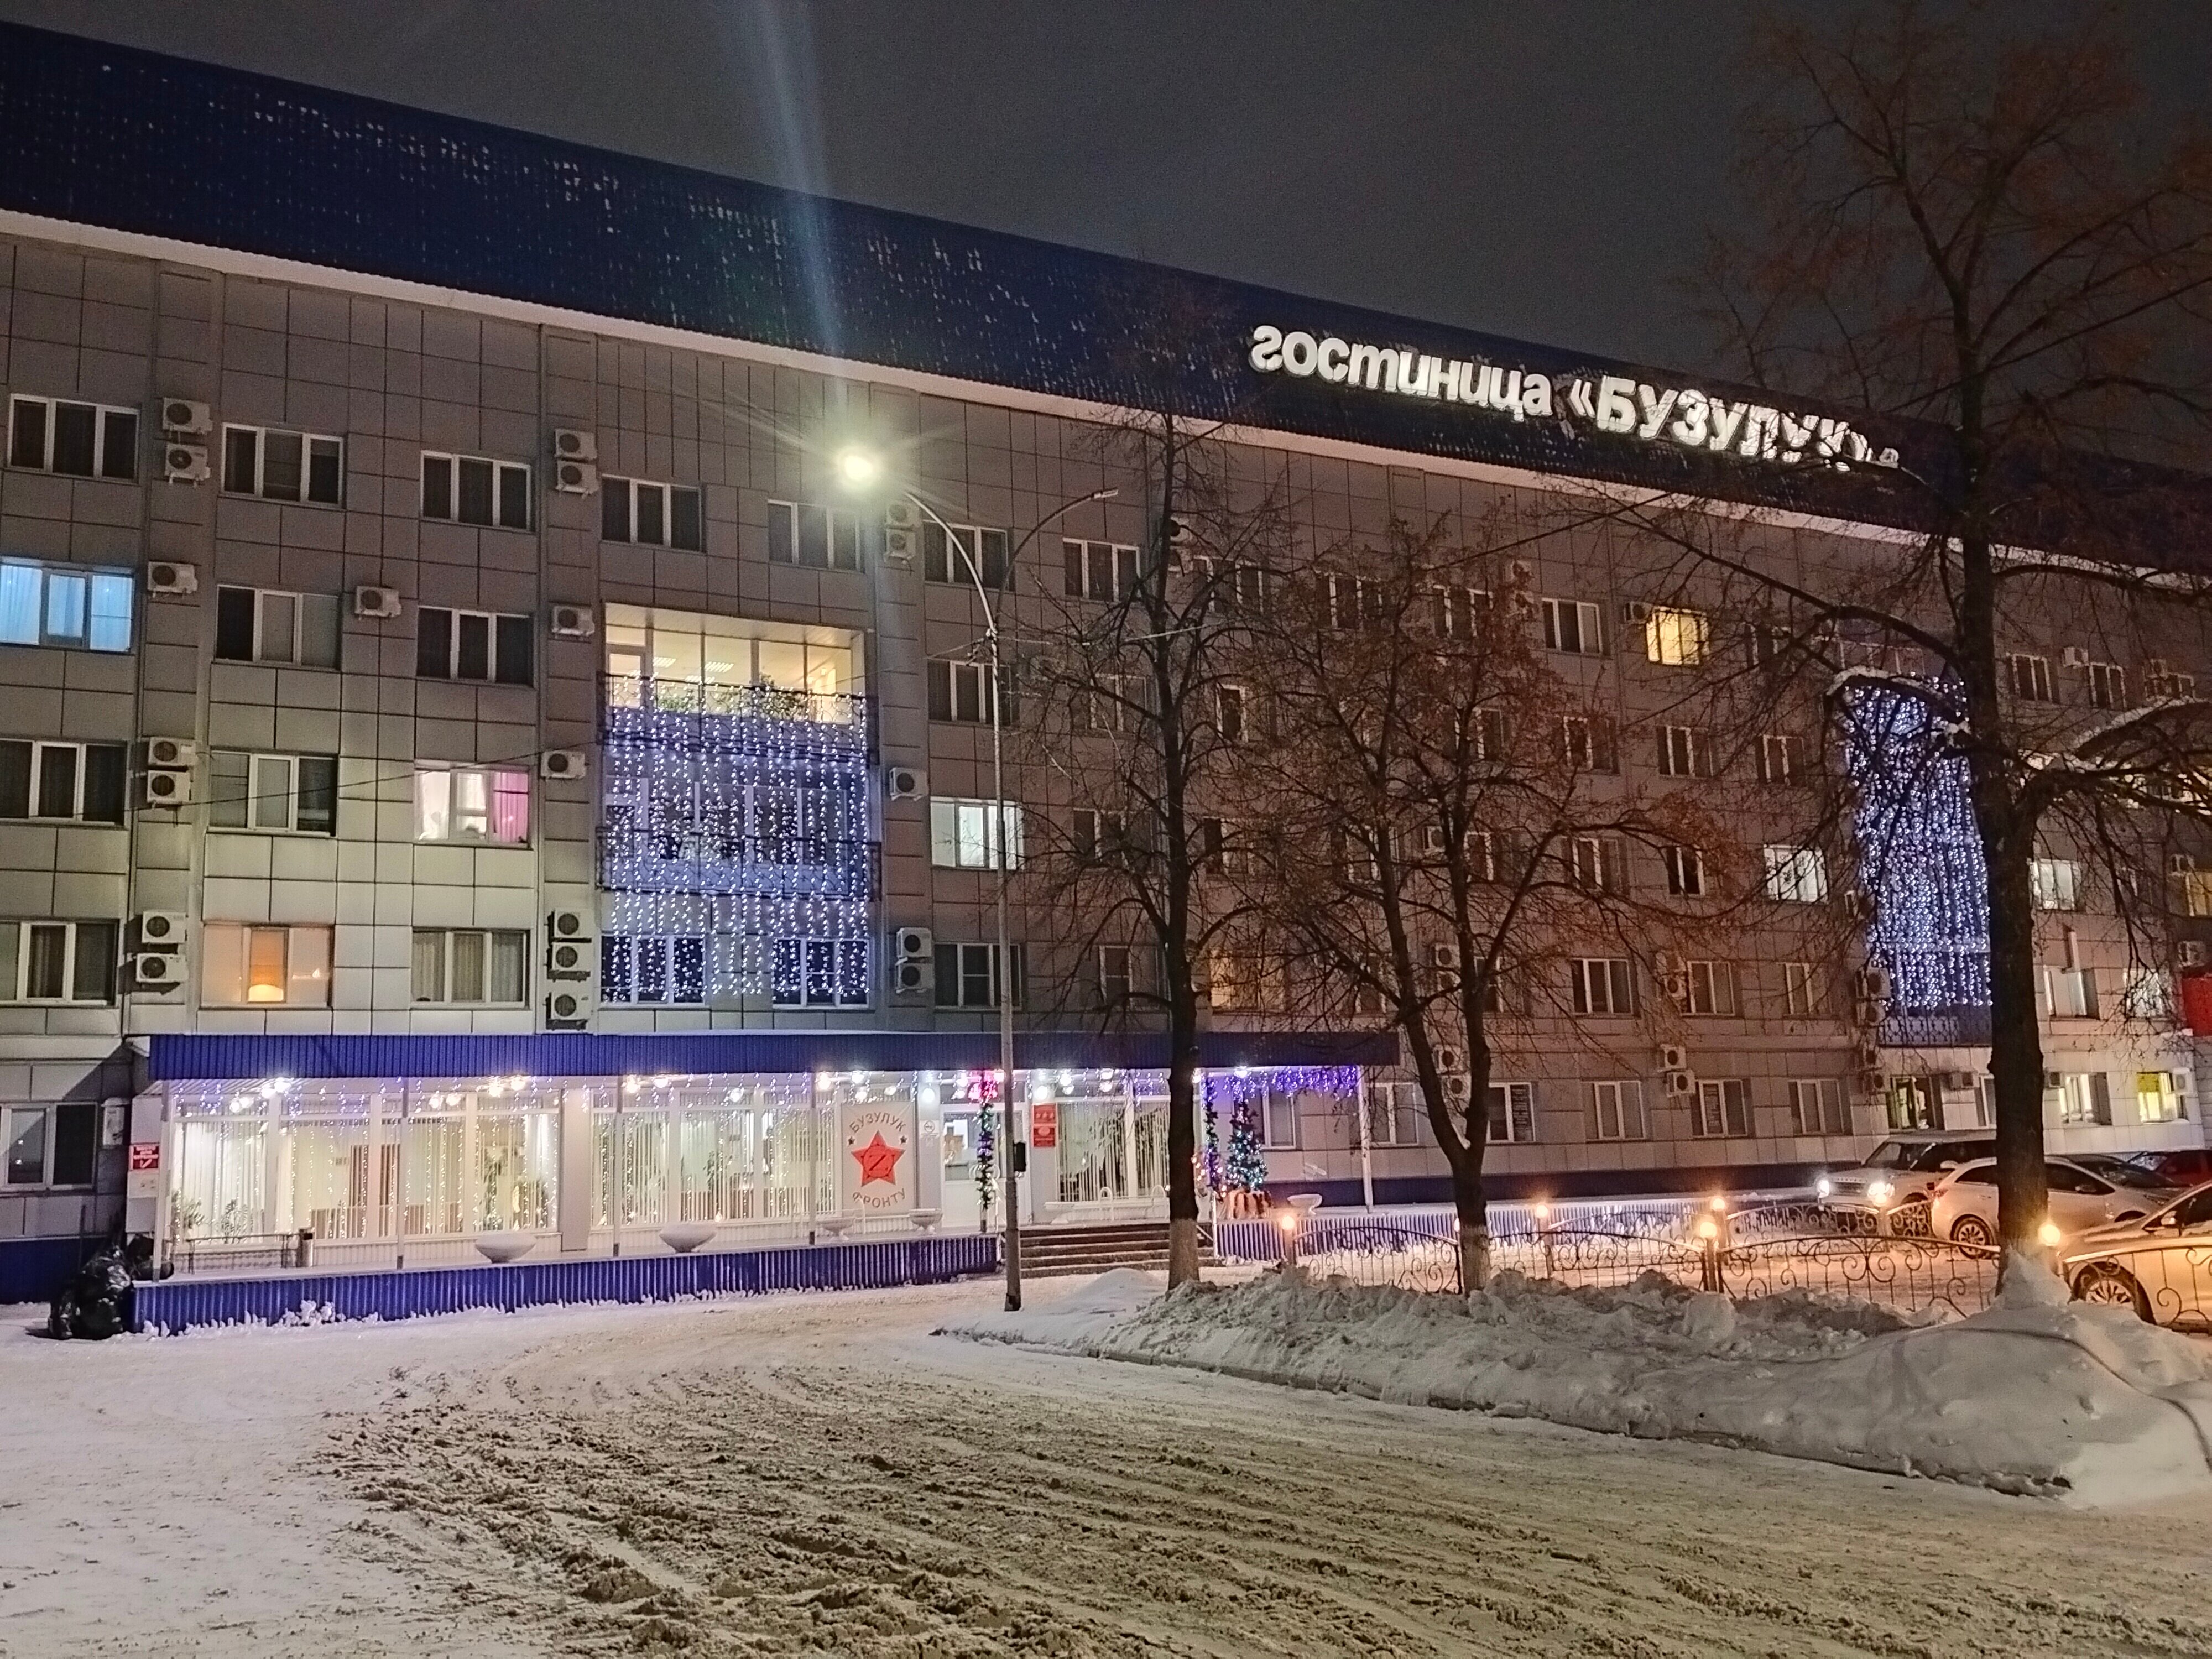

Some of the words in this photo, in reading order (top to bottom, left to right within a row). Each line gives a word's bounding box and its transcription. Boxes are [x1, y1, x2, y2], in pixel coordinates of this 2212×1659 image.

[1250, 325, 1552, 422] гостиница
[849, 1112, 907, 1134] БУЗУЛУК
[852, 1187, 906, 1208] ФРОНТУ
